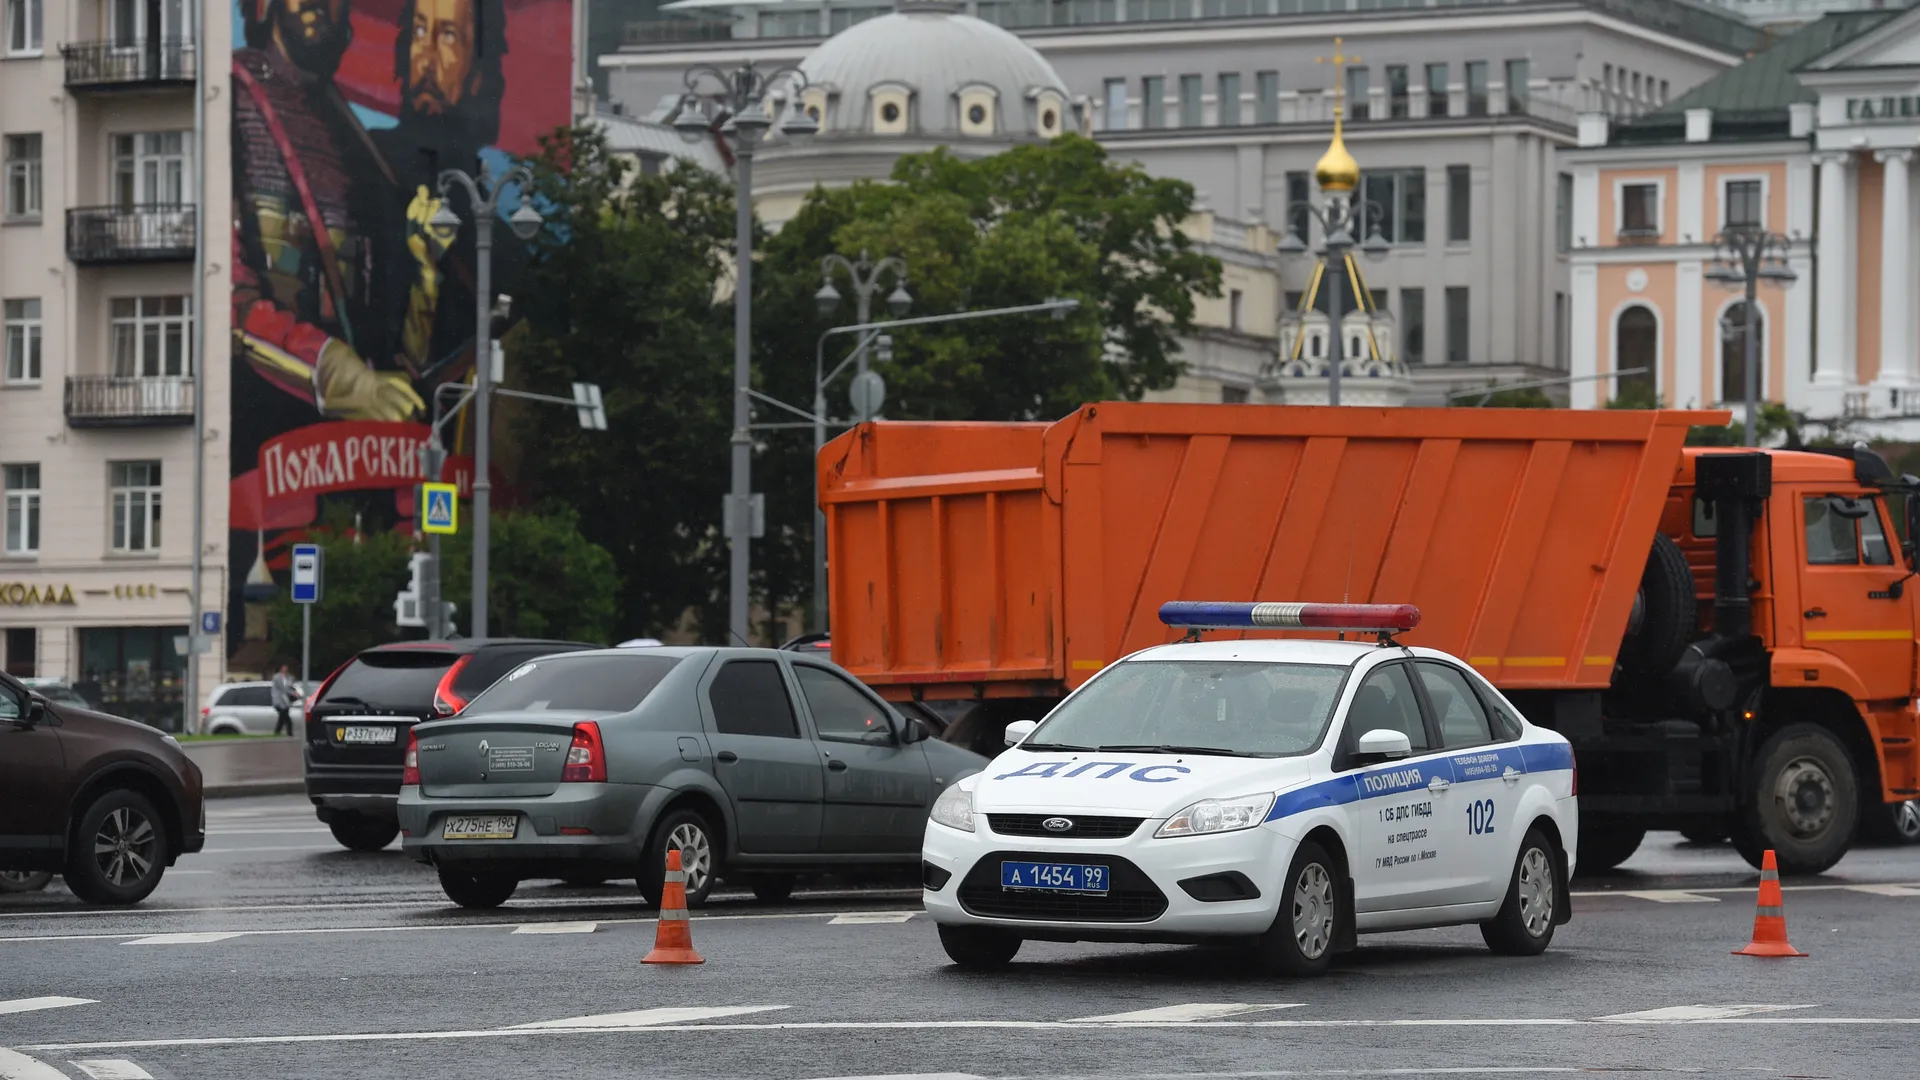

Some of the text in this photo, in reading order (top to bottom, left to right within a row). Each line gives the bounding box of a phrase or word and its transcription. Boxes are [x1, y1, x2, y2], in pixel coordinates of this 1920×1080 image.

[1846, 95, 1920, 119] ГАЛЕ
[535, 742, 560, 750] LOGAN
[993, 761, 1191, 783] ДПС
[1364, 768, 1422, 793] ПОЛИЦИЯ
[1385, 807, 1395, 822] СБ
[1396, 804, 1410, 822] ДПС
[1411, 801, 1433, 818] ГИБДД
[1466, 798, 1495, 835] 102
[1048, 819, 1067, 830] Ford
[1387, 828, 1428, 844] на спецтрассе
[1375, 858, 1382, 869] ГУ
[1382, 855, 1393, 869] МВД
[1394, 855, 1410, 866] России
[1411, 853, 1417, 863] по
[1011, 865, 1102, 887] А 1454 99
